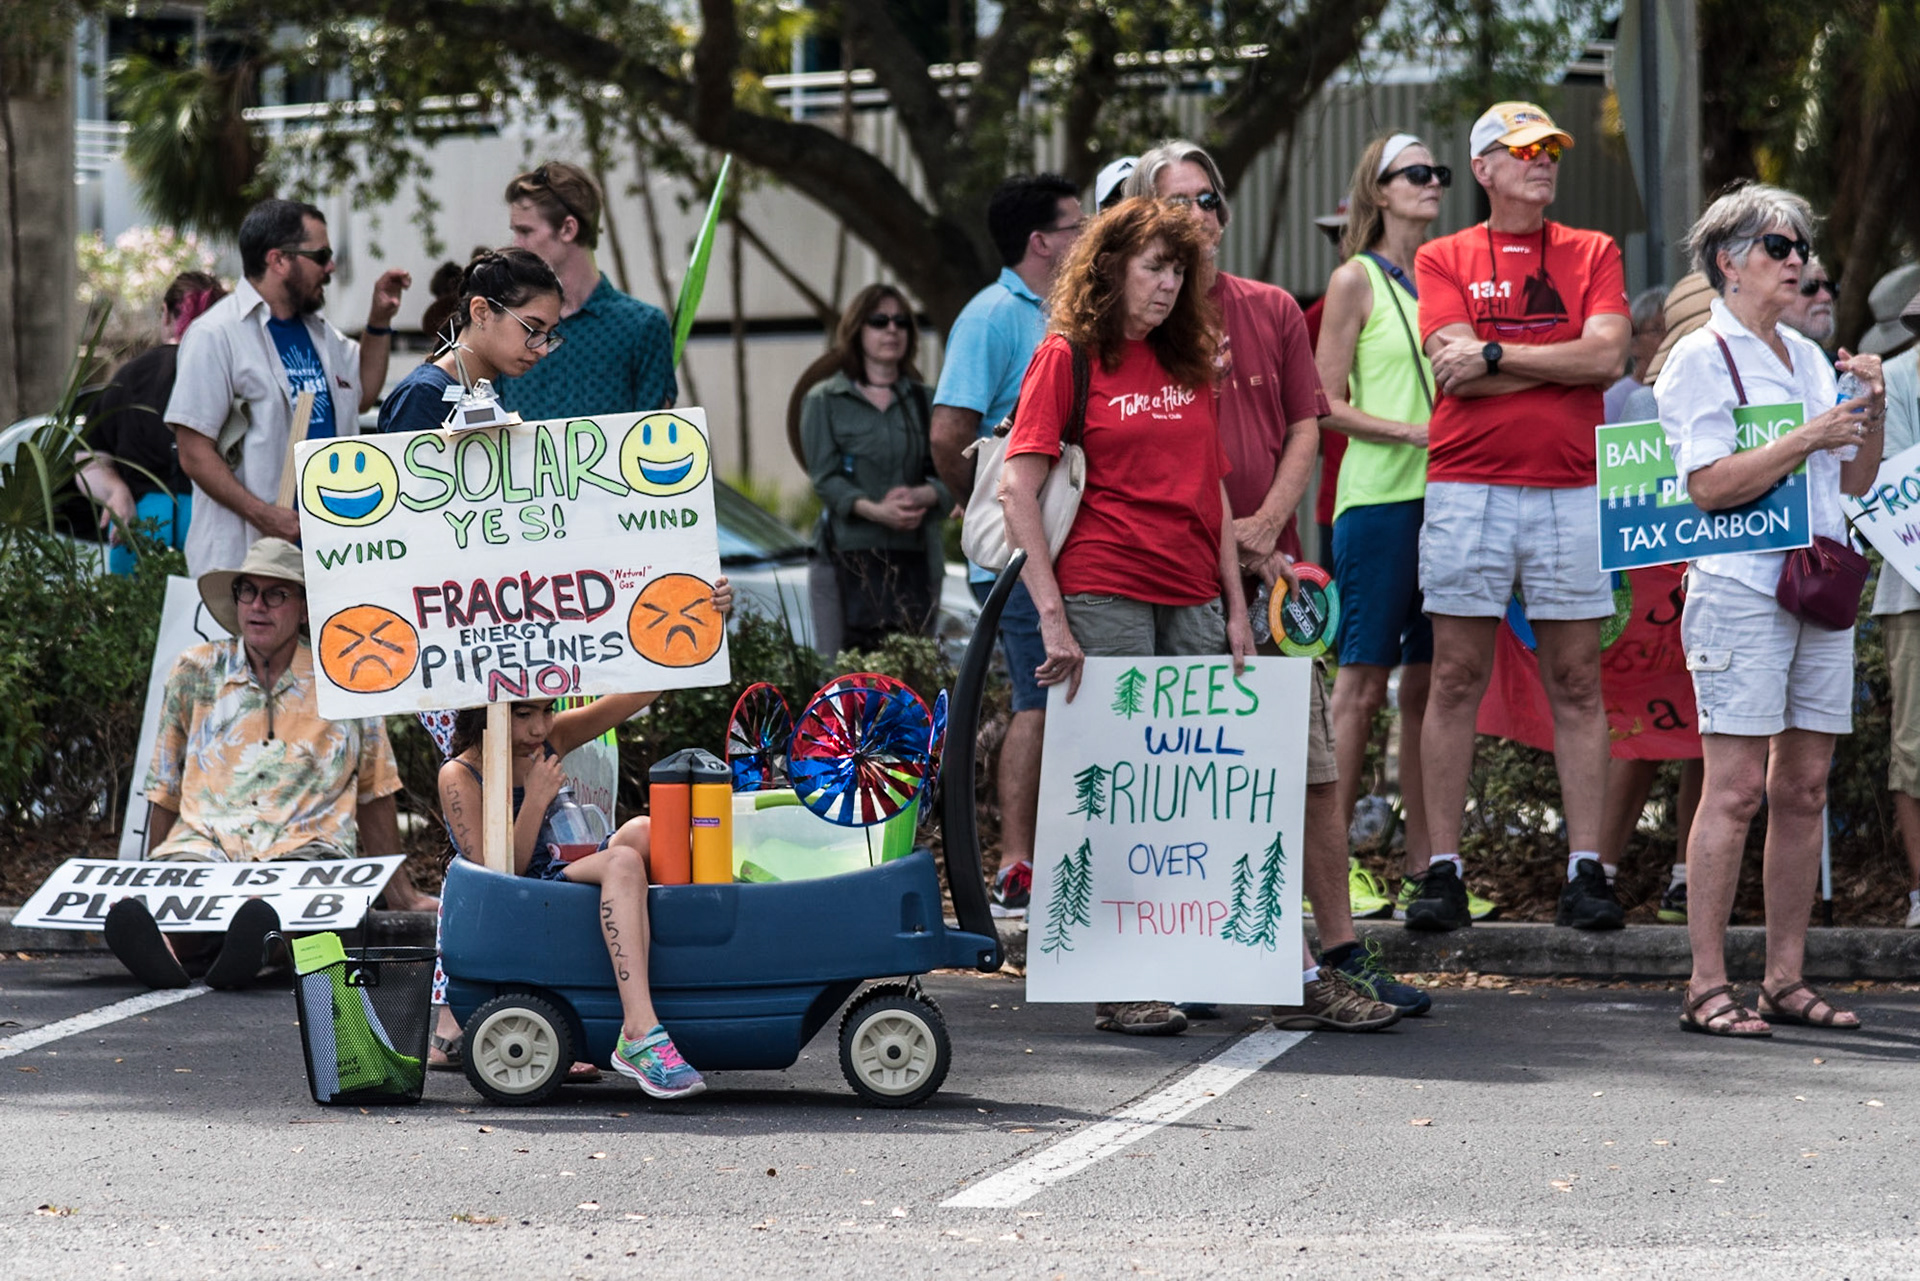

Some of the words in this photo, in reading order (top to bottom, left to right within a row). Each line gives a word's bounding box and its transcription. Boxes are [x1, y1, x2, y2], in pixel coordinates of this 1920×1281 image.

[1468, 281, 1511, 299] 13.1
[1108, 393, 1151, 421] Take
[1152, 397, 1162, 408] a
[1160, 385, 1196, 412] Hike
[399, 419, 631, 511] SOLAR
[1606, 437, 1661, 468] BAN
[444, 504, 567, 548] YES!
[618, 508, 699, 532] WIND
[1618, 523, 1668, 552] TAX
[1675, 507, 1790, 545] CARBON
[316, 539, 408, 570] WIND
[412, 569, 616, 629] FRACKED
[619, 580, 635, 590] Gas
[459, 621, 560, 647] ENERGY
[421, 631, 625, 689] PIPELINES
[487, 664, 582, 701] NO!
[1145, 726, 1244, 756] WILL
[72, 864, 214, 887] THERE
[232, 868, 287, 886] IS
[298, 864, 385, 886] NO
[1128, 842, 1208, 880] OVER
[301, 894, 345, 918] B
[1101, 900, 1228, 936] TRUMP
[601, 899, 630, 981] 5526
